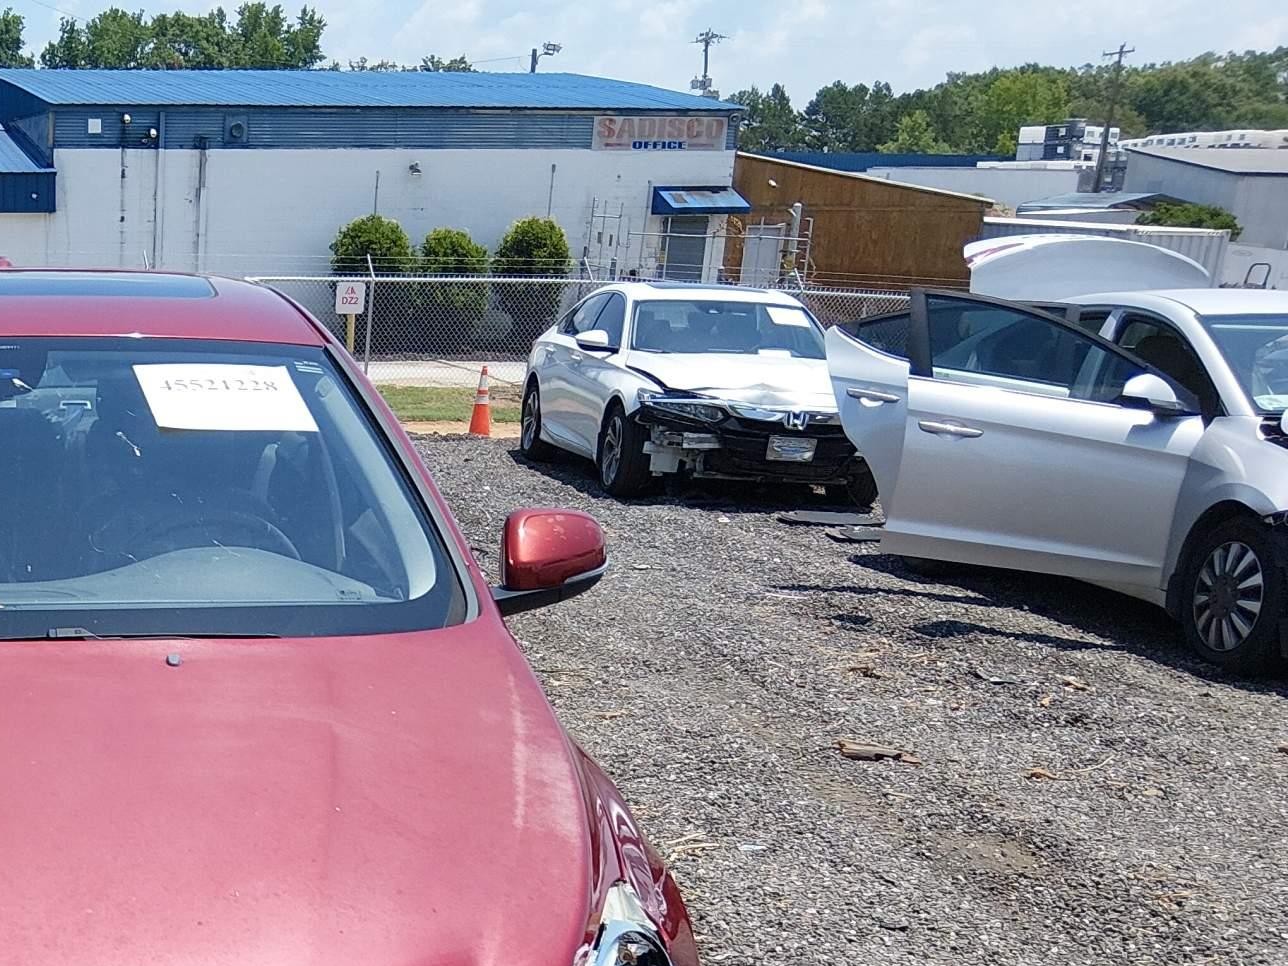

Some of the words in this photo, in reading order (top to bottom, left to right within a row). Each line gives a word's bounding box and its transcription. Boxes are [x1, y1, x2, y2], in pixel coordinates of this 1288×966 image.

[598, 118, 724, 139] SADISCO
[632, 141, 687, 150] OFFICE
[341, 296, 359, 305] DZ2
[160, 379, 278, 392] 45521228
